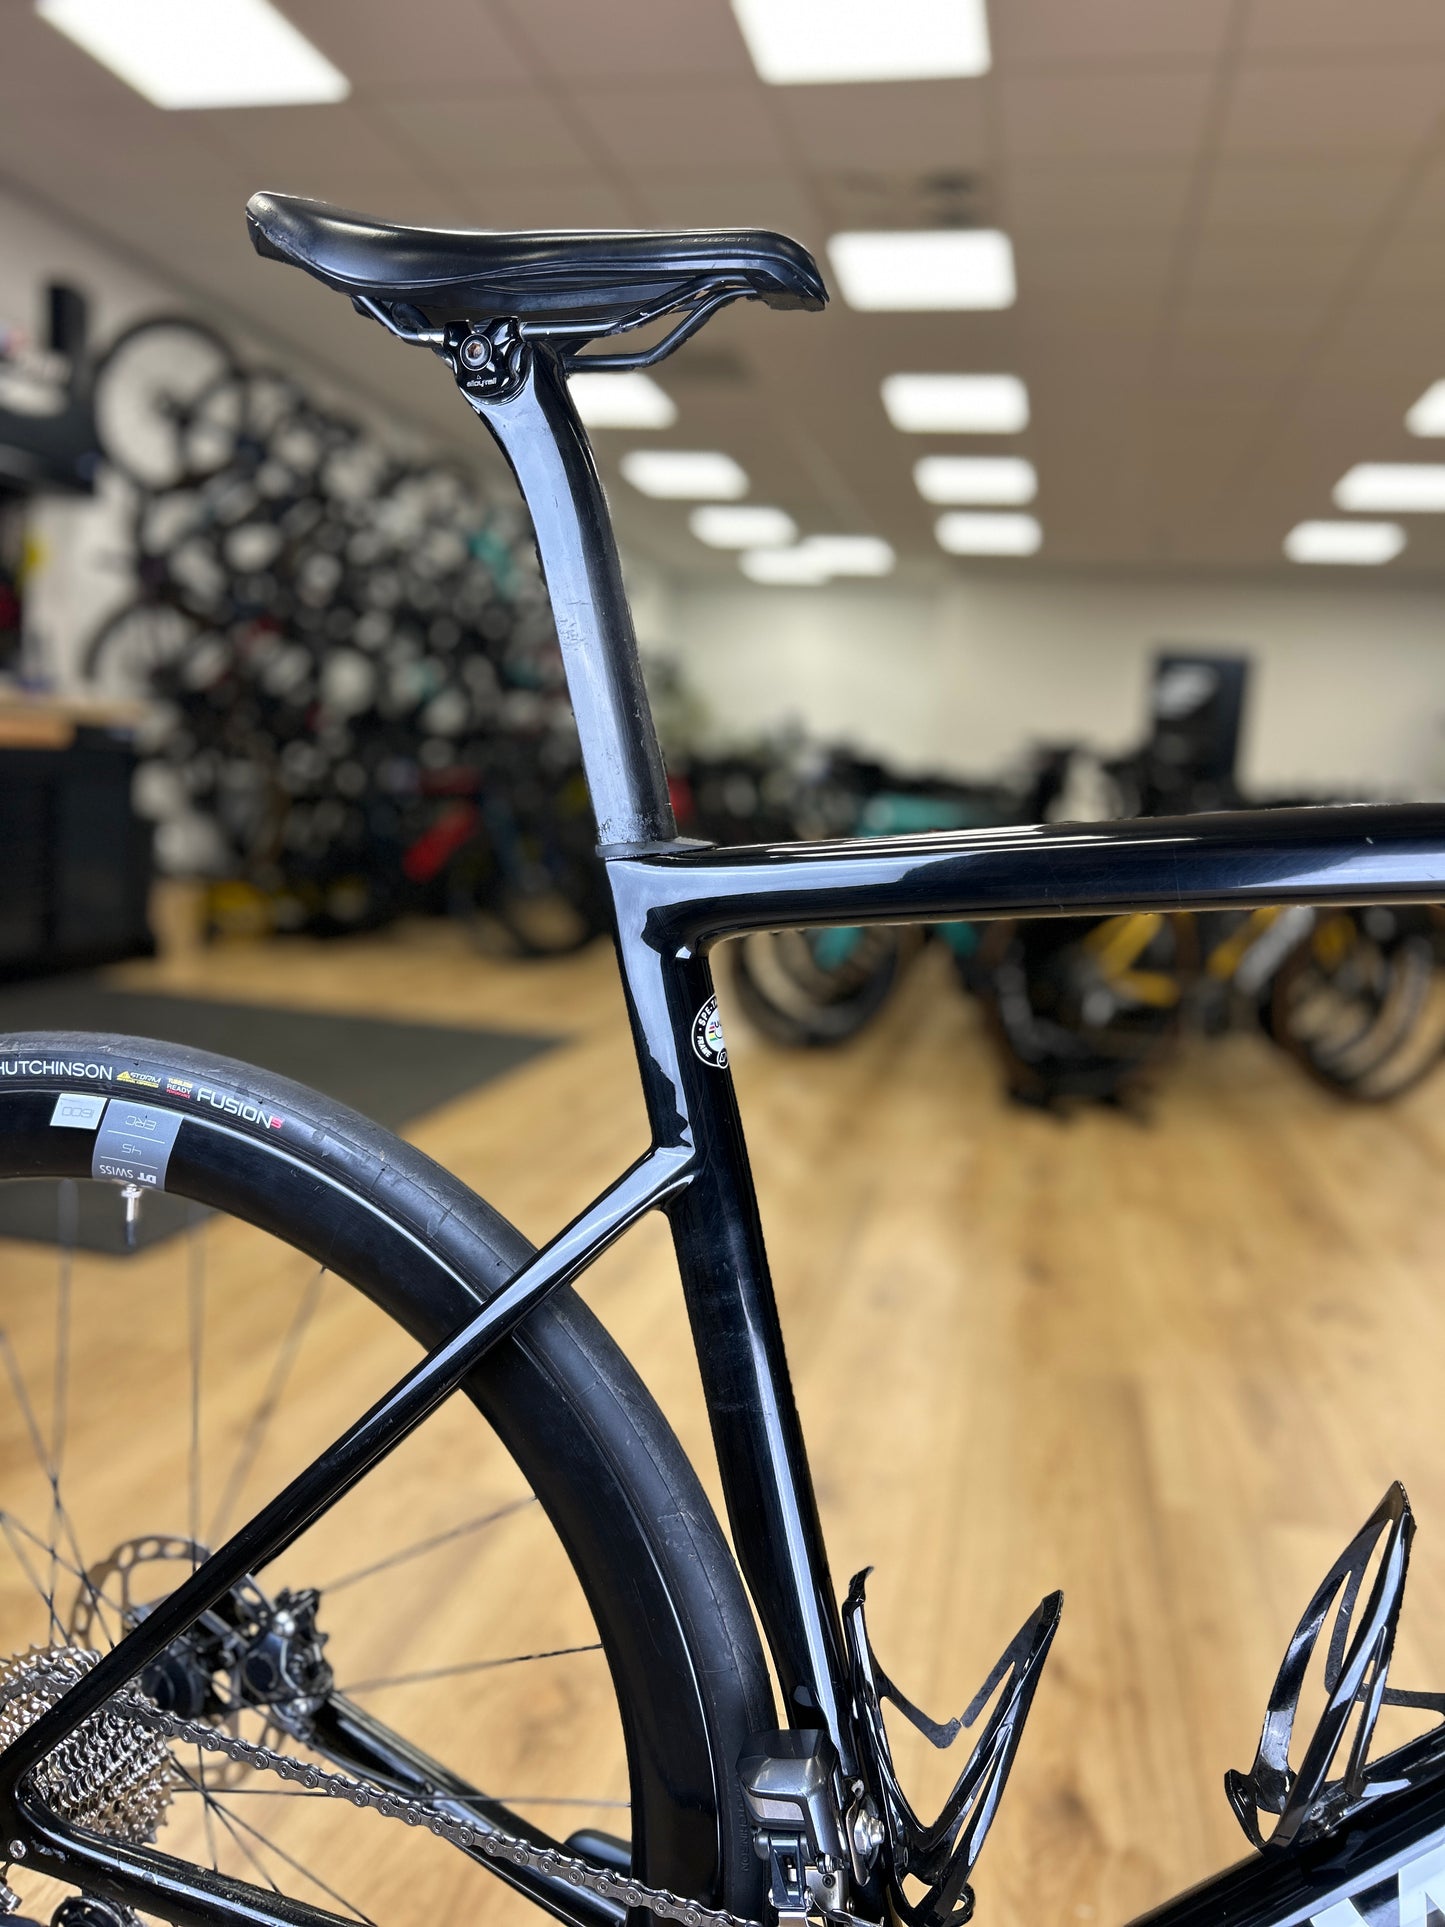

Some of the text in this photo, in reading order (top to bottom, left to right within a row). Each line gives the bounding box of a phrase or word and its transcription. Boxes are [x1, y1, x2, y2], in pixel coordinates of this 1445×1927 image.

[166, 1083, 192, 1095] READY
[125, 1115, 157, 1131] ERC
[99, 1164, 157, 1185] DT SWISS
